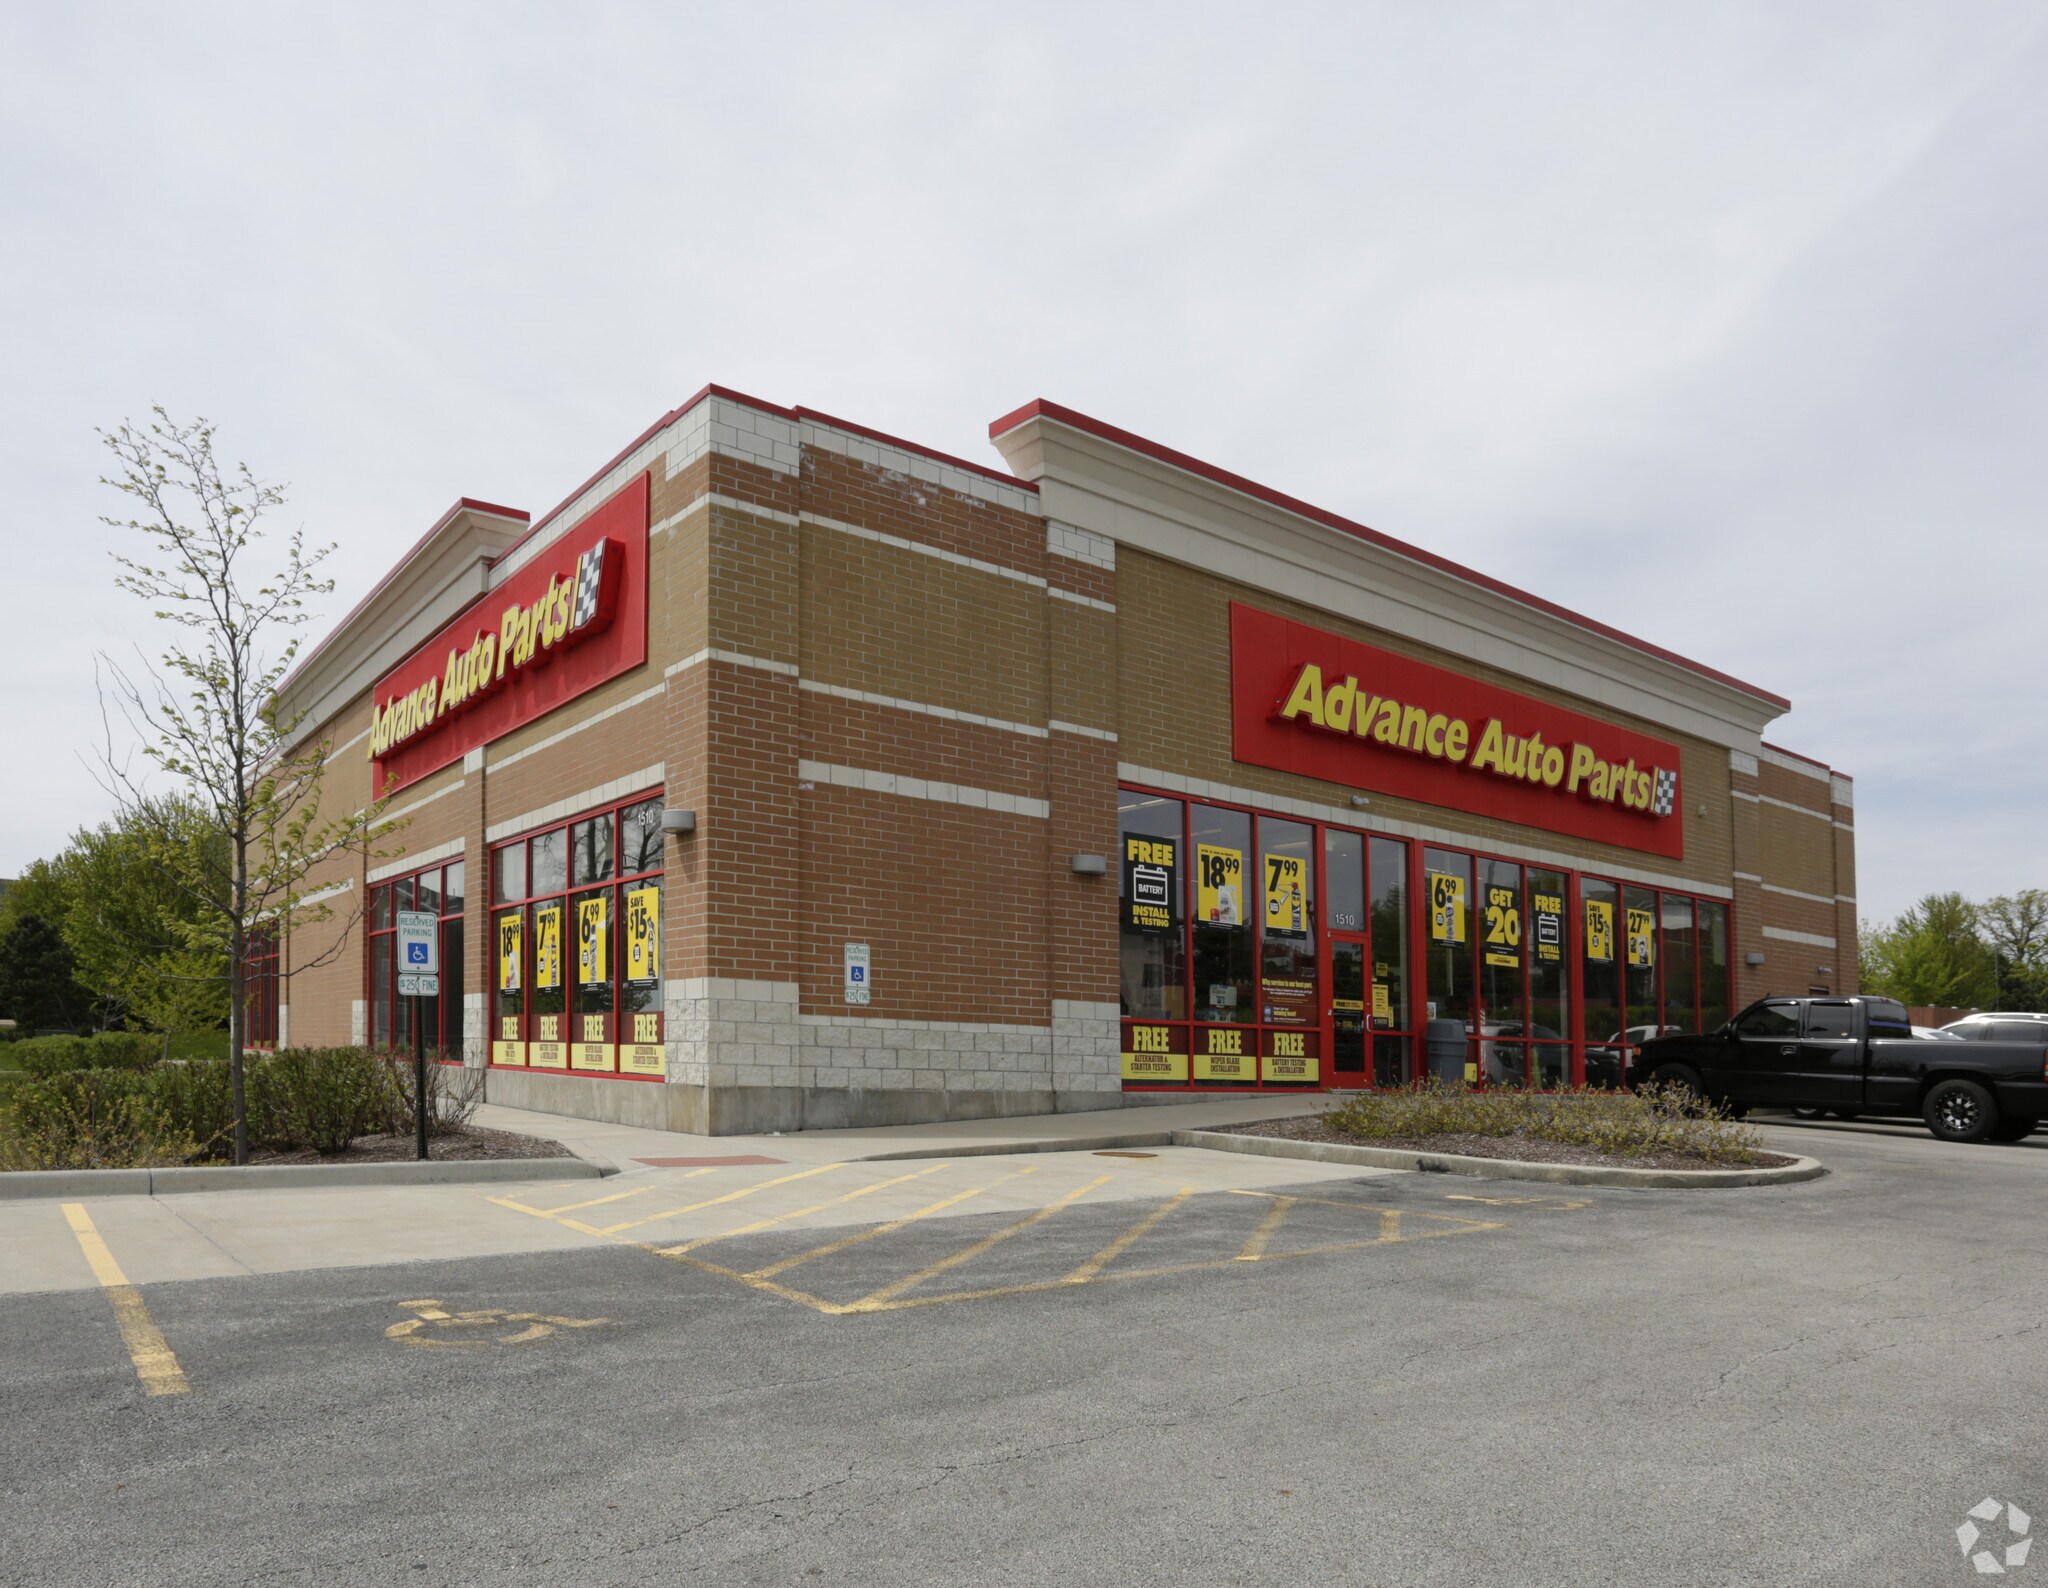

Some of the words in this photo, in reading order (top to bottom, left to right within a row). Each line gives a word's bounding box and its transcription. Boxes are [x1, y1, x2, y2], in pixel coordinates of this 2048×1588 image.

[368, 676, 438, 760] Advance
[438, 628, 496, 718] Auto
[1281, 662, 1470, 763] Advance
[1471, 716, 1565, 788] Auto
[638, 809, 654, 826] 1510
[1127, 839, 1174, 868] FREE
[1138, 884, 1164, 896] BATTERY
[1490, 888, 1513, 908] GET
[630, 896, 644, 908] SAVE
[1133, 905, 1170, 919] INSTALL
[1535, 894, 1561, 914] FREE
[401, 918, 434, 927] RESERVED
[630, 907, 648, 940] $15
[1133, 916, 1140, 925] &
[1141, 917, 1169, 928] TESTING
[1335, 912, 1355, 926] 1510
[403, 928, 432, 937] PARKING
[1539, 944, 1560, 954] INSTALL
[423, 979, 437, 991] FINE
[503, 1016, 518, 1040] FREE
[540, 1015, 558, 1041] FREE
[584, 1014, 604, 1042] FREE
[634, 1013, 658, 1043] FREE
[1132, 1026, 1169, 1052] FREE
[1208, 1029, 1241, 1054] FREE
[1274, 1032, 1304, 1056] FREE
